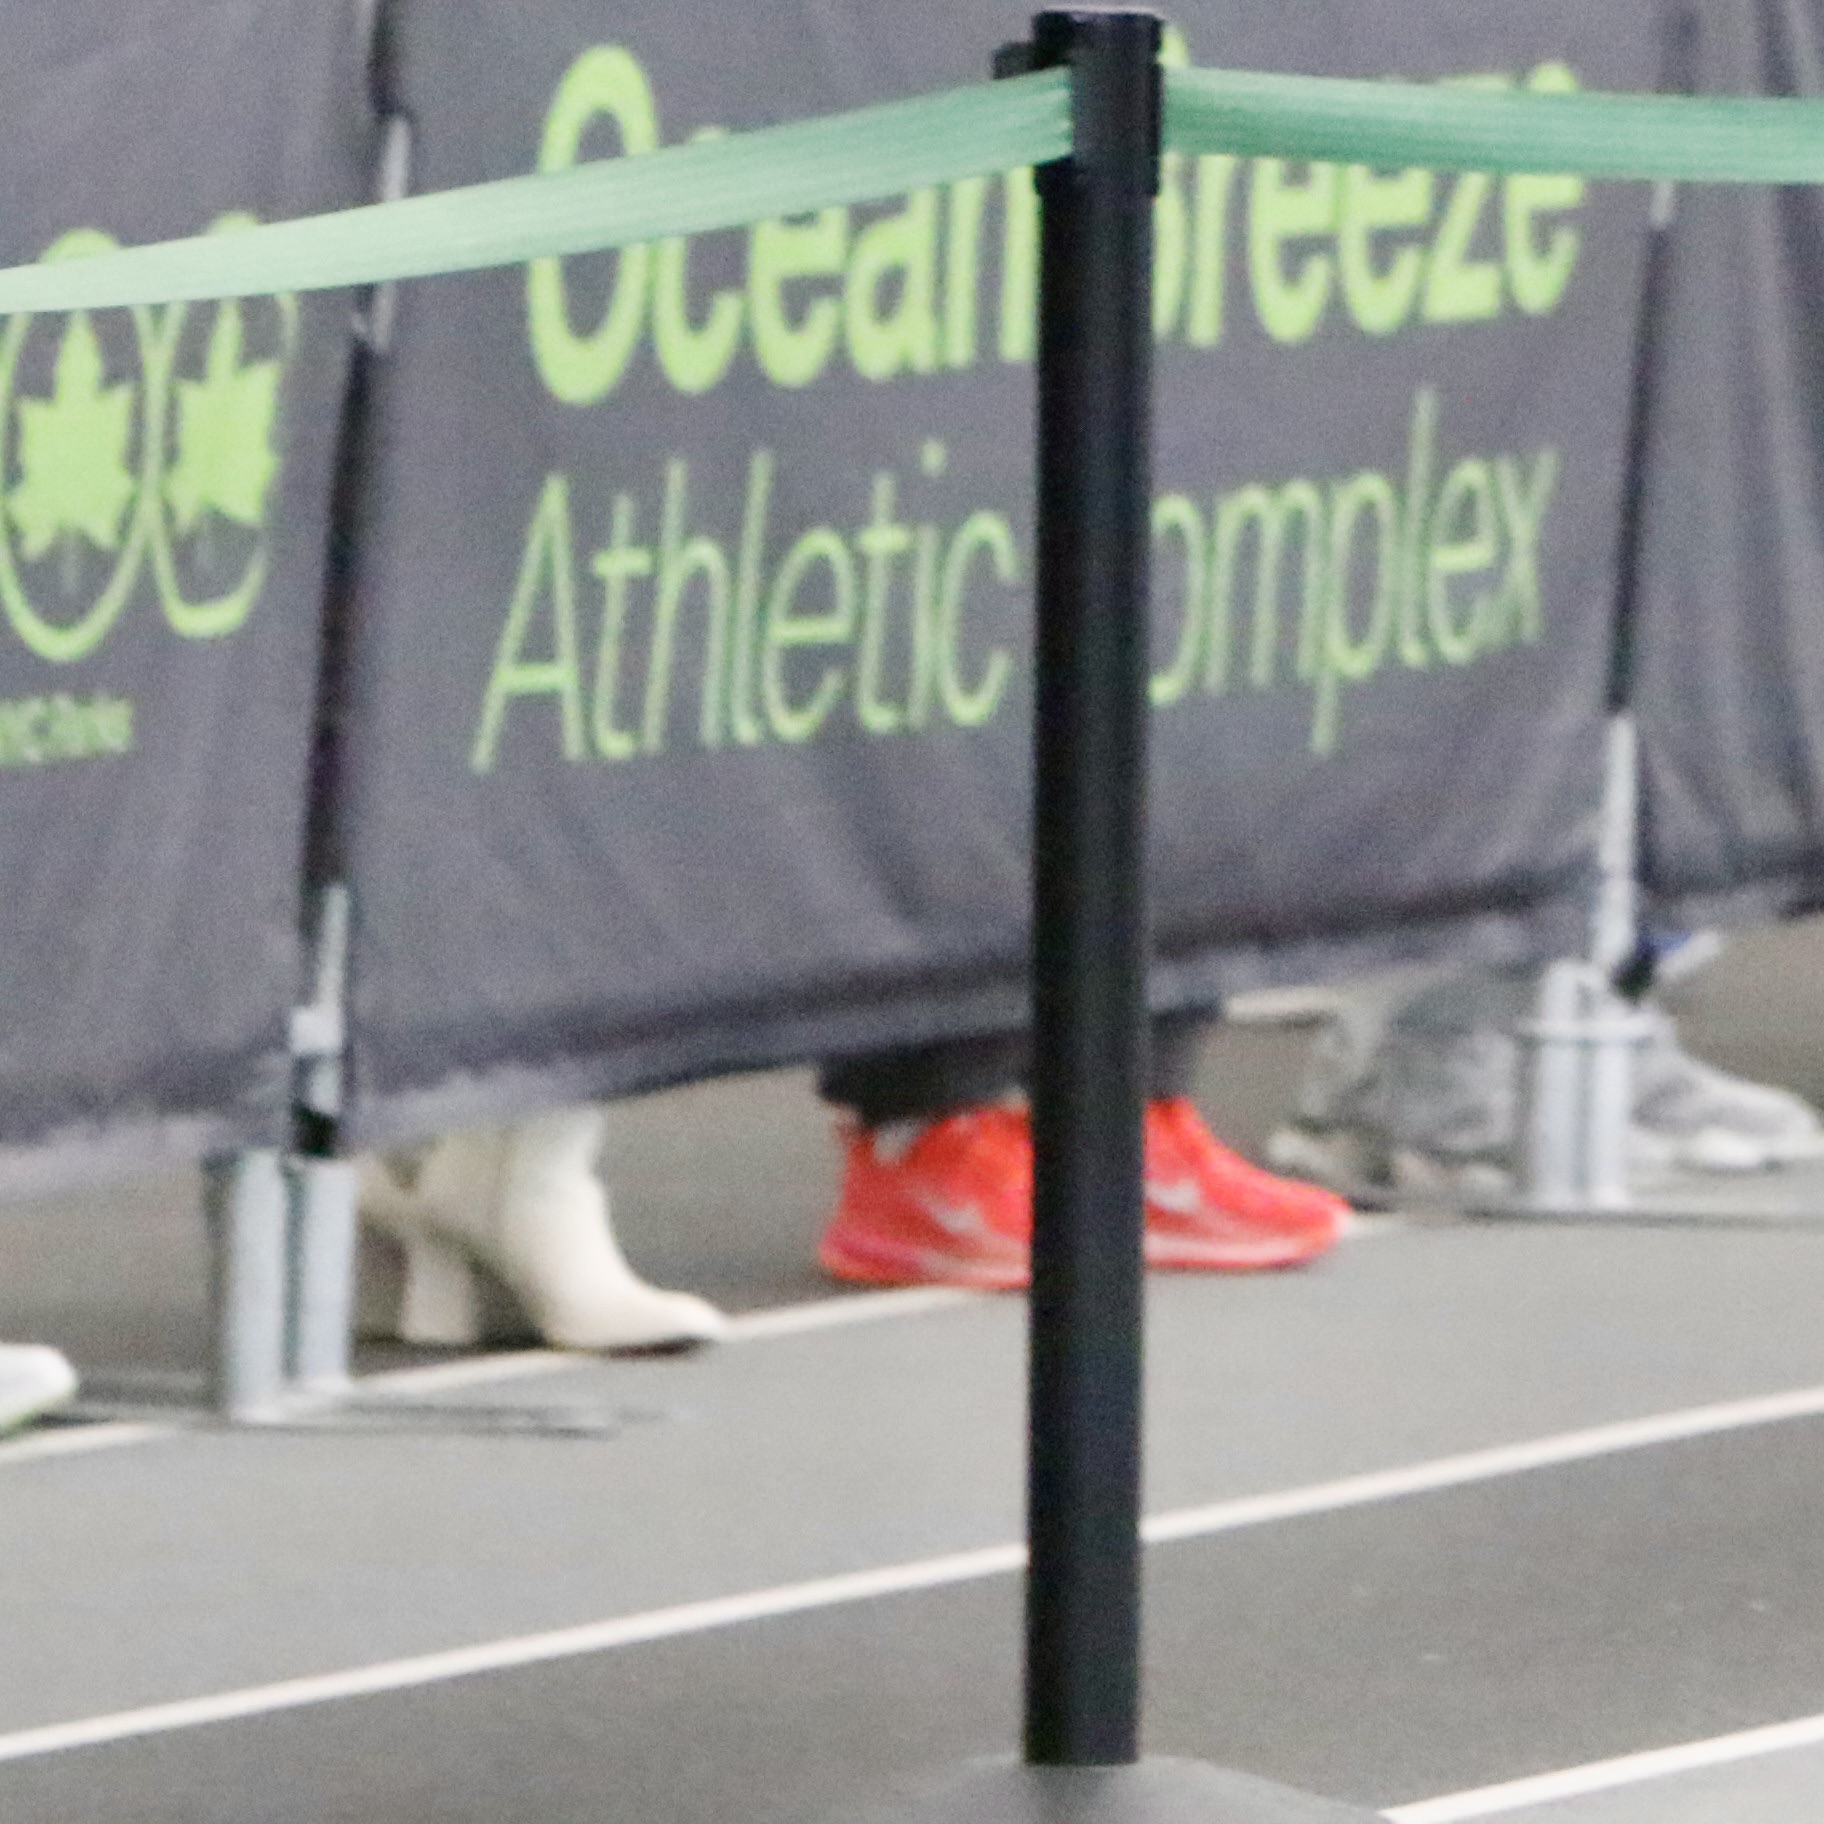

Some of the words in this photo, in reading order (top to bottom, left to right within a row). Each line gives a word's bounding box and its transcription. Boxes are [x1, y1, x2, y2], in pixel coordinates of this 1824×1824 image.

[1152, 24, 1585, 348] reeze
[470, 436, 1022, 774] Athletic
[1149, 384, 1562, 758] omplex
